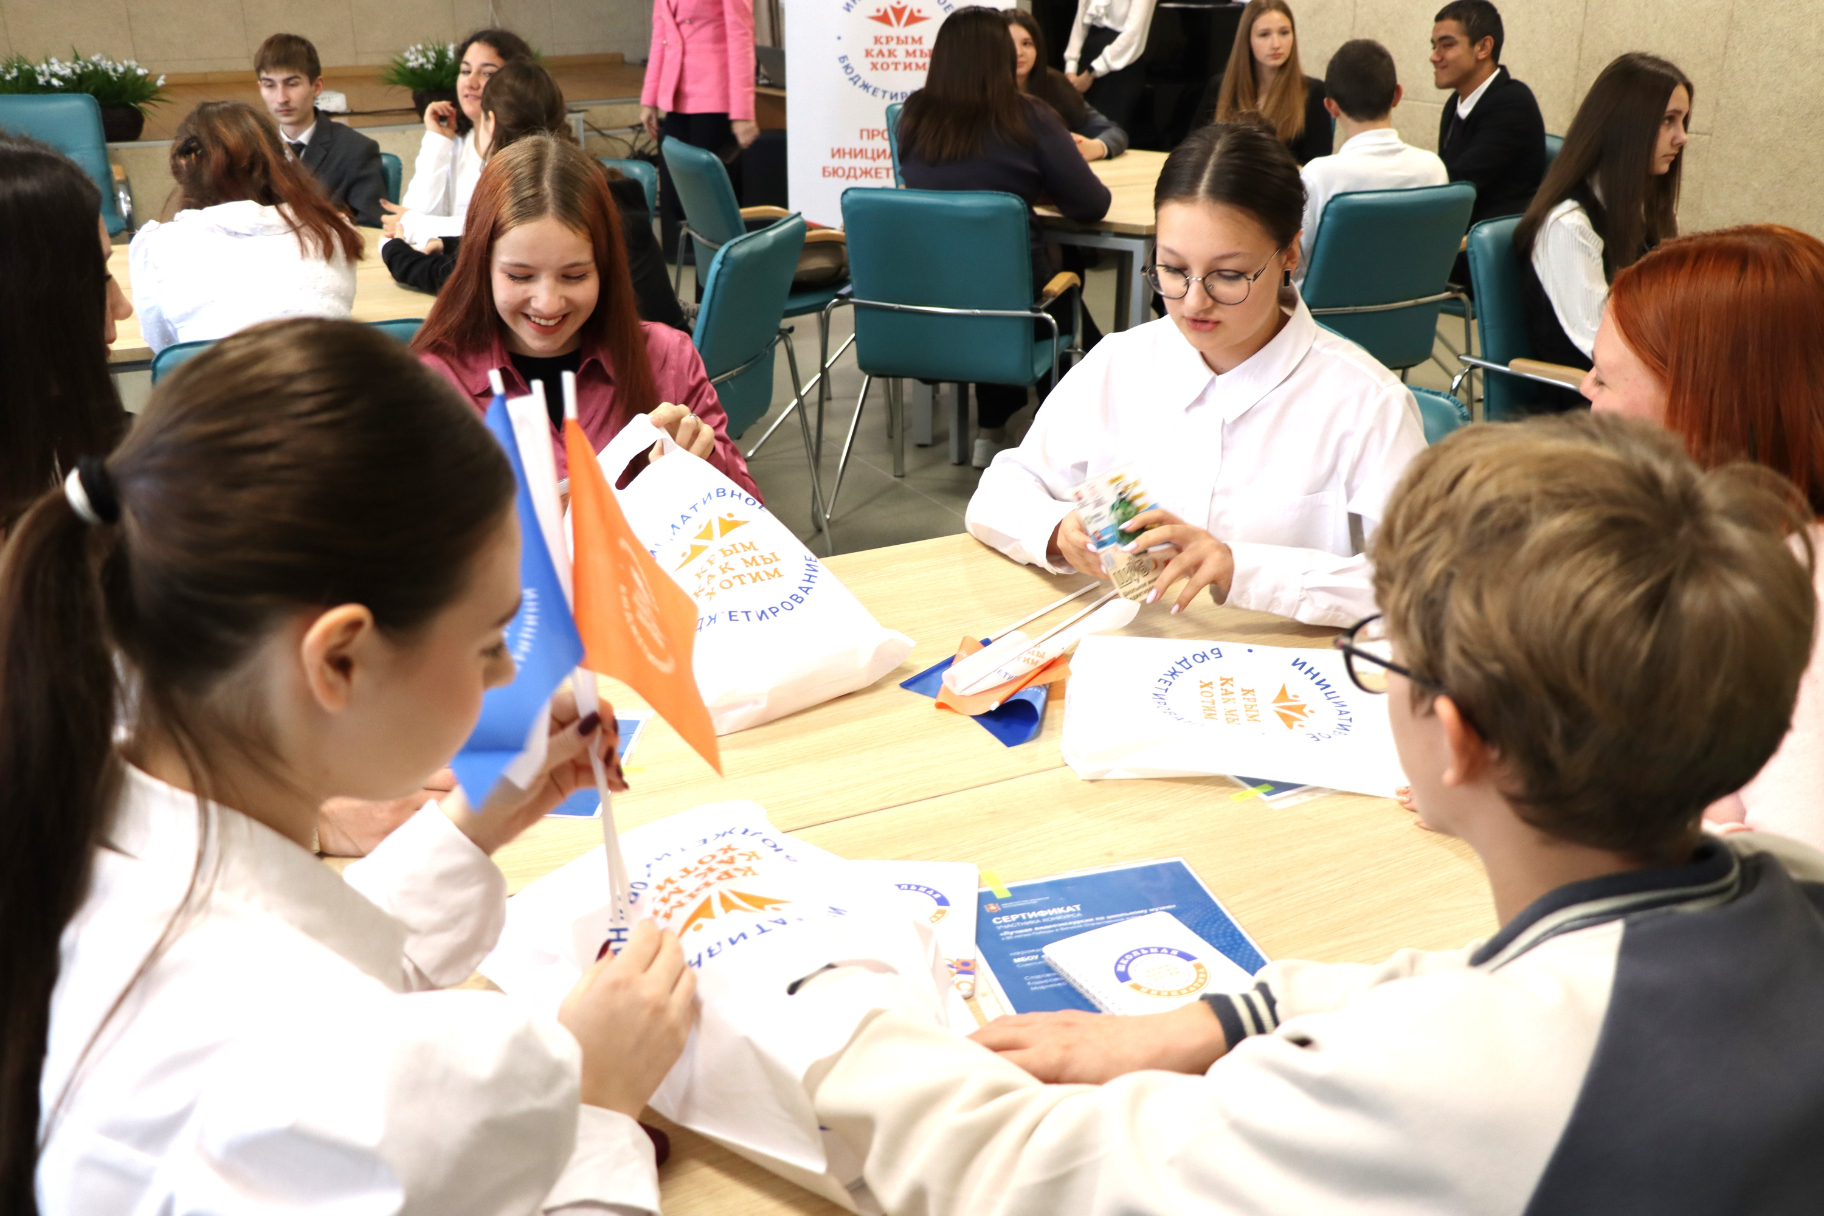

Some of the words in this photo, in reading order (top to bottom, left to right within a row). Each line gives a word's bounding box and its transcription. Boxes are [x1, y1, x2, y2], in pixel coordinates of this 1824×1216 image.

[864, 48, 897, 59] КАК
[905, 48, 933, 59] МЫ
[873, 35, 923, 46] КРЫМ
[838, 54, 918, 101] БЮДЖЕТИР
[870, 61, 928, 72] ХОТИМ
[859, 128, 890, 141] ПРО
[822, 166, 893, 181] БЮДЖЕТ
[695, 541, 759, 580] КРЫМ
[693, 561, 735, 599] КАК
[740, 551, 782, 568] МЫ
[705, 567, 784, 601] ХОТИМ
[1199, 680, 1219, 721] ХОТИМ
[1219, 676, 1236, 704] КАК
[1223, 708, 1241, 726] МЫ
[1241, 687, 1262, 723] КРЫМ
[662, 866, 760, 920] КРЫМ
[992, 904, 1082, 924] СЕРТИФИКАТ
